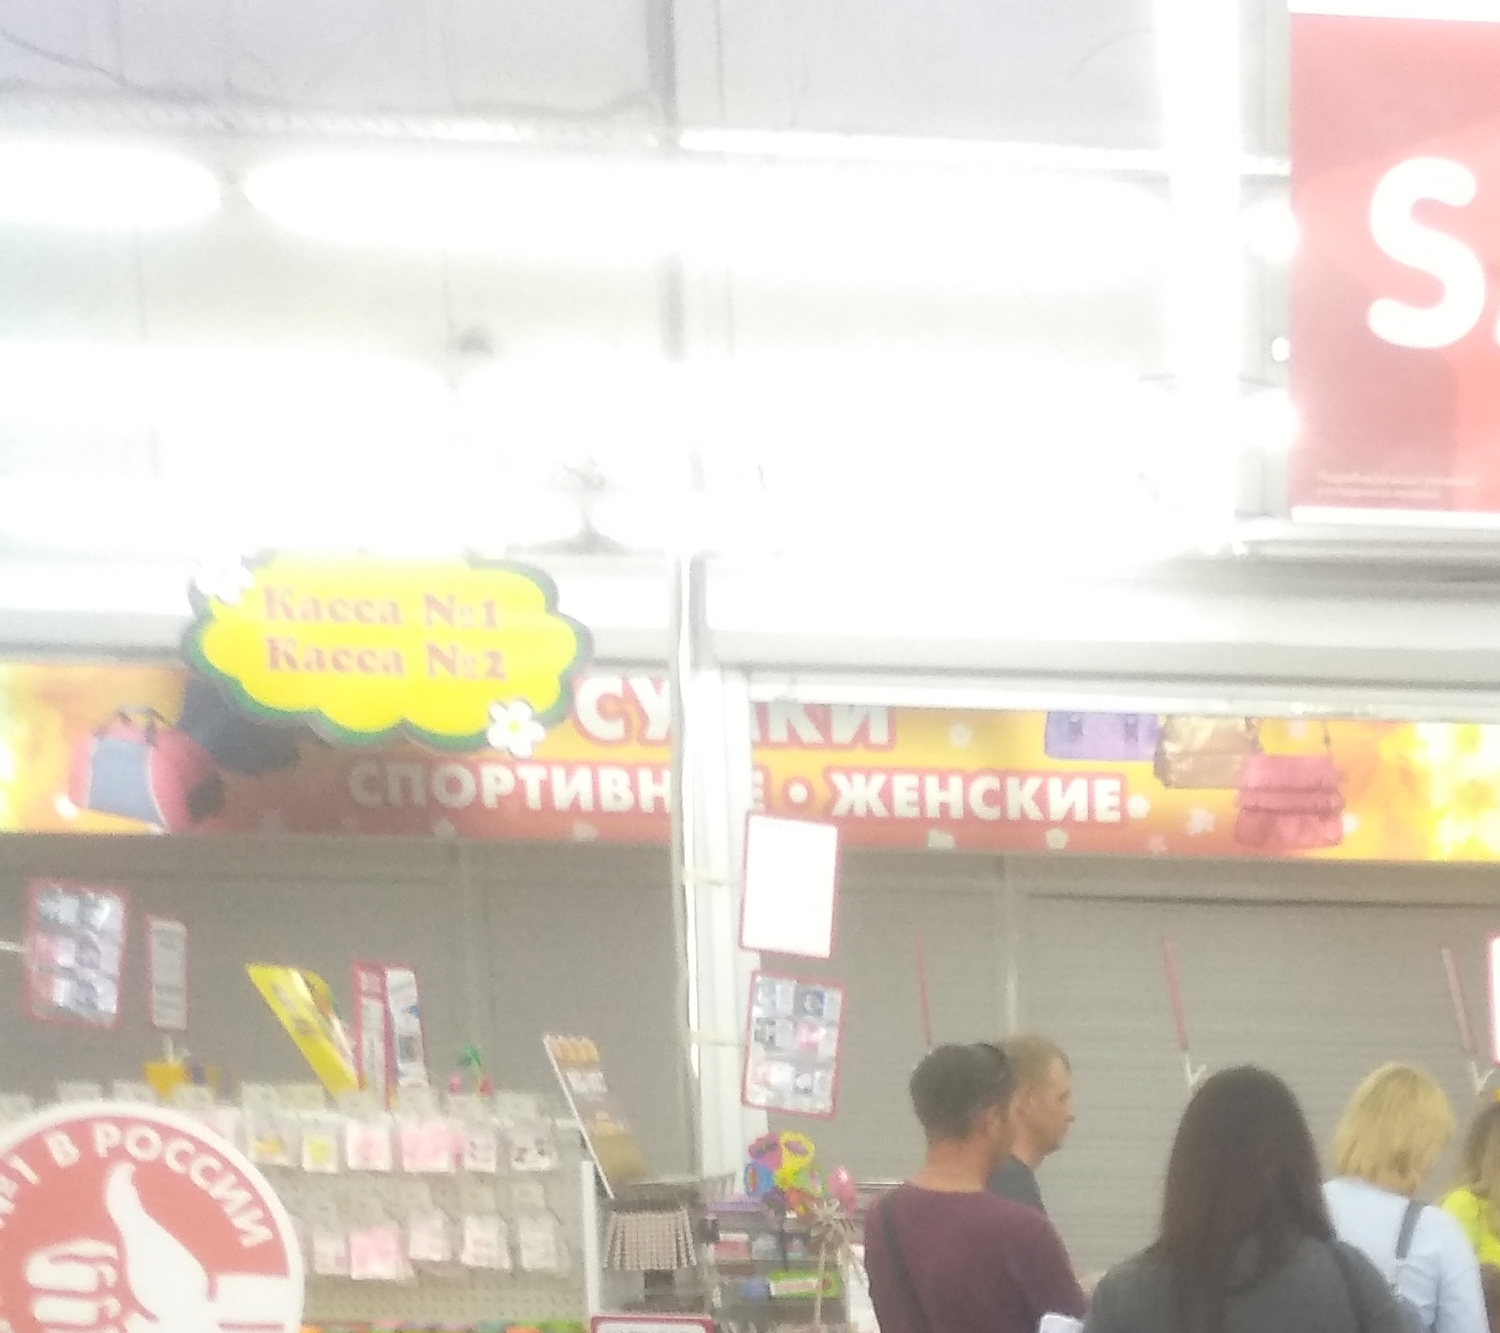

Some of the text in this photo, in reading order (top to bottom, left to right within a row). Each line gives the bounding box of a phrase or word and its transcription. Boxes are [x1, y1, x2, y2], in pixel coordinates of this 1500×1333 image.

[264, 586, 402, 624] Касса
[267, 636, 407, 675] Касса
[574, 677, 890, 745] СУКИ
[347, 761, 1123, 824] СПОРТИВН ЖЕНСКИЕ
[44, 1129, 81, 1169] В
[93, 1121, 273, 1248] РОССИИ
